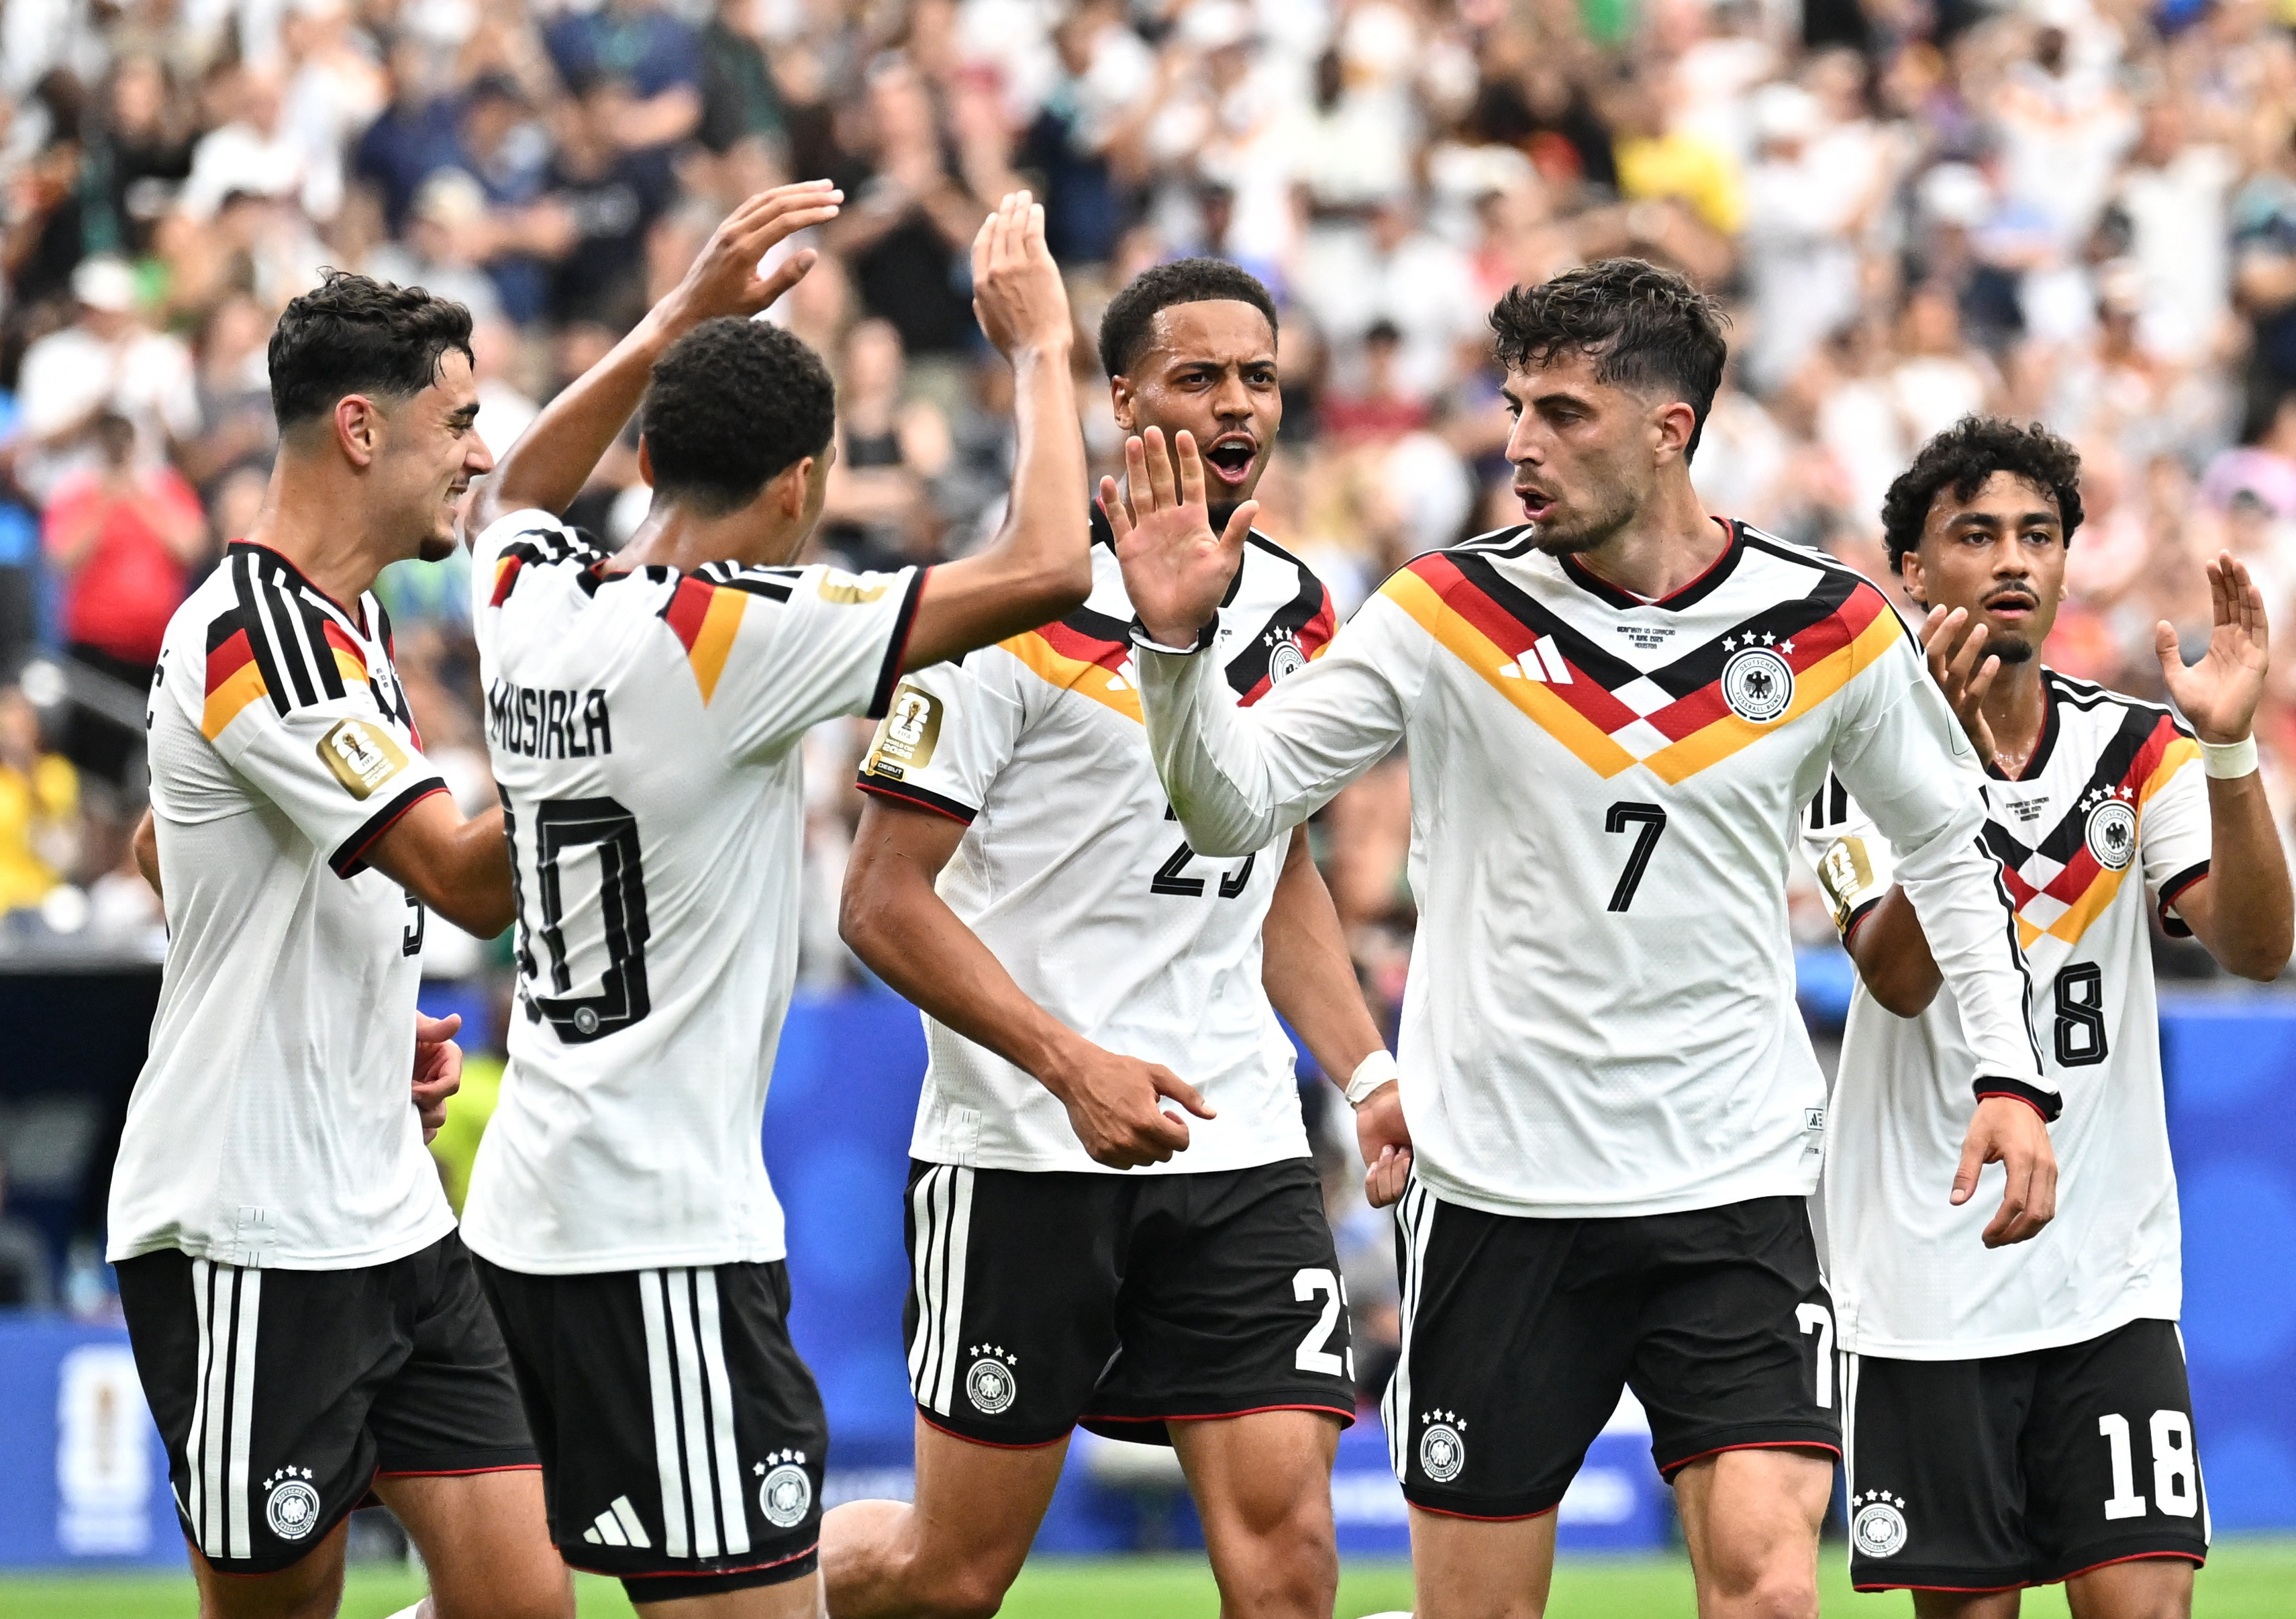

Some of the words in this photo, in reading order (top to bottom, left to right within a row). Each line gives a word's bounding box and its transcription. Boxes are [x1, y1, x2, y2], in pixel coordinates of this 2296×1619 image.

[1739, 659, 1777, 673] DEUTSCHER
[489, 677, 612, 760] MUSIALA
[897, 730, 911, 739] FIFA
[362, 756, 375, 767] FIFA
[877, 763, 903, 775] DEBUT
[1605, 801, 1666, 912] 7
[1795, 1302, 1834, 1409] 7
[977, 1365, 1005, 1379] DEUTSCHER
[2099, 1410, 2198, 1520] 18
[276, 1489, 307, 1504] DEUTSCHER
